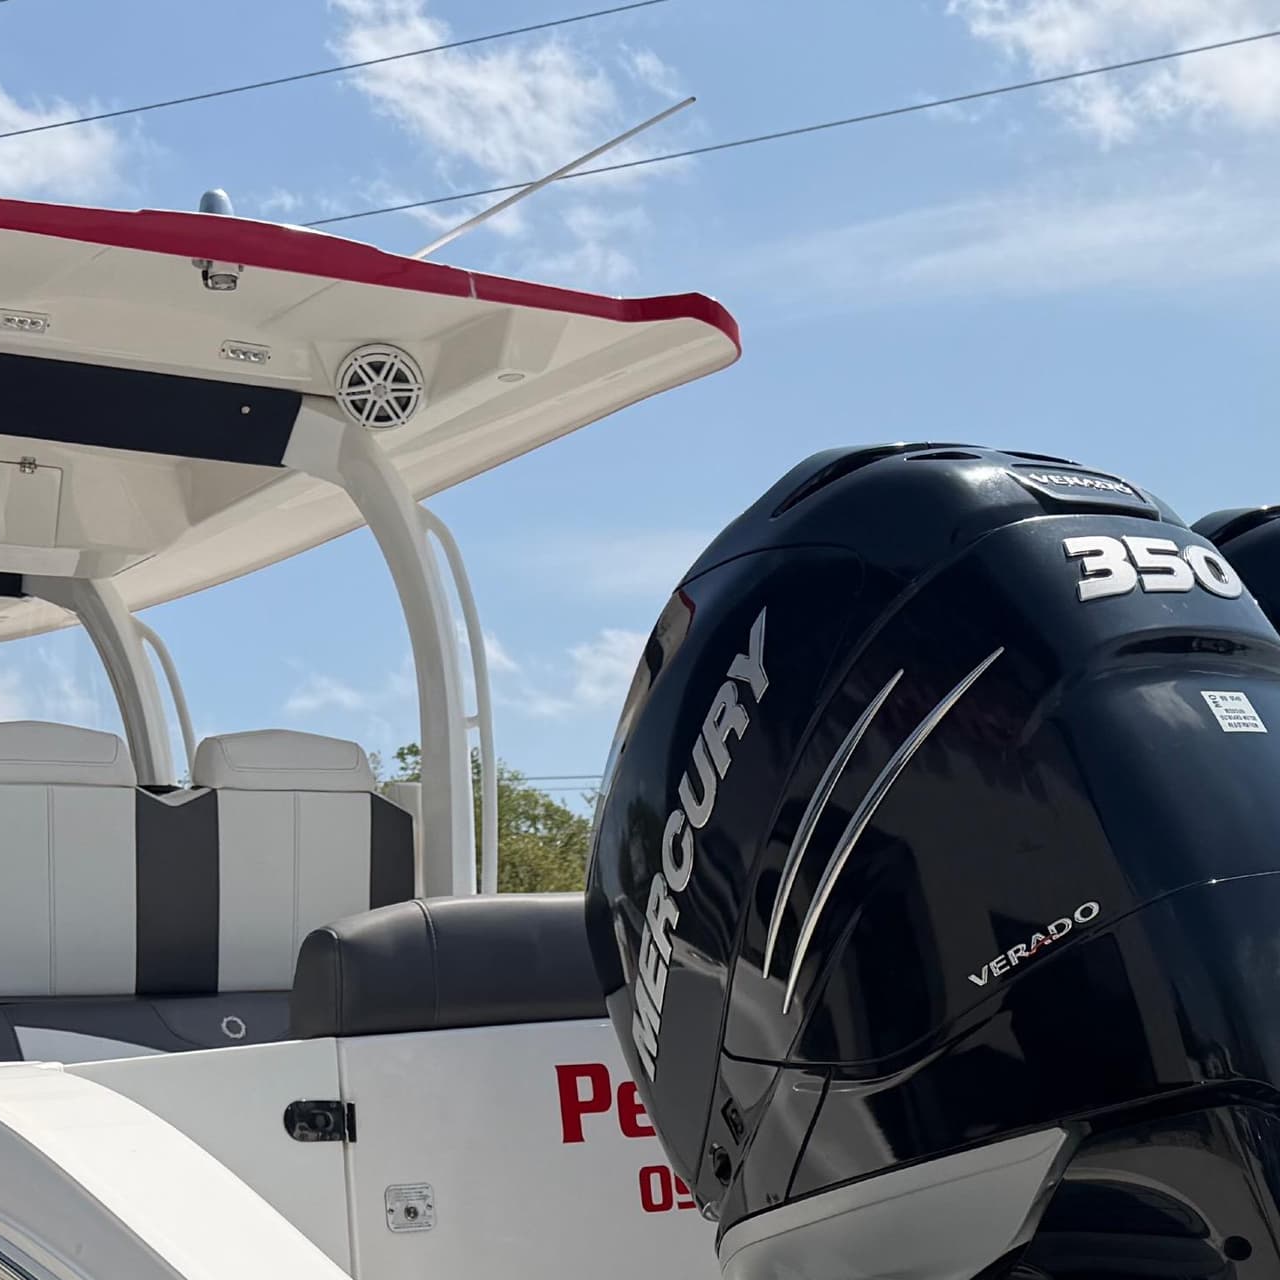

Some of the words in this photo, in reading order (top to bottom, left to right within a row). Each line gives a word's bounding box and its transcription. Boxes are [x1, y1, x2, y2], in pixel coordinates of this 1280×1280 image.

[1063, 535, 1243, 602] 350
[631, 606, 770, 1083] MERCURY
[967, 901, 1100, 986] VERADO
